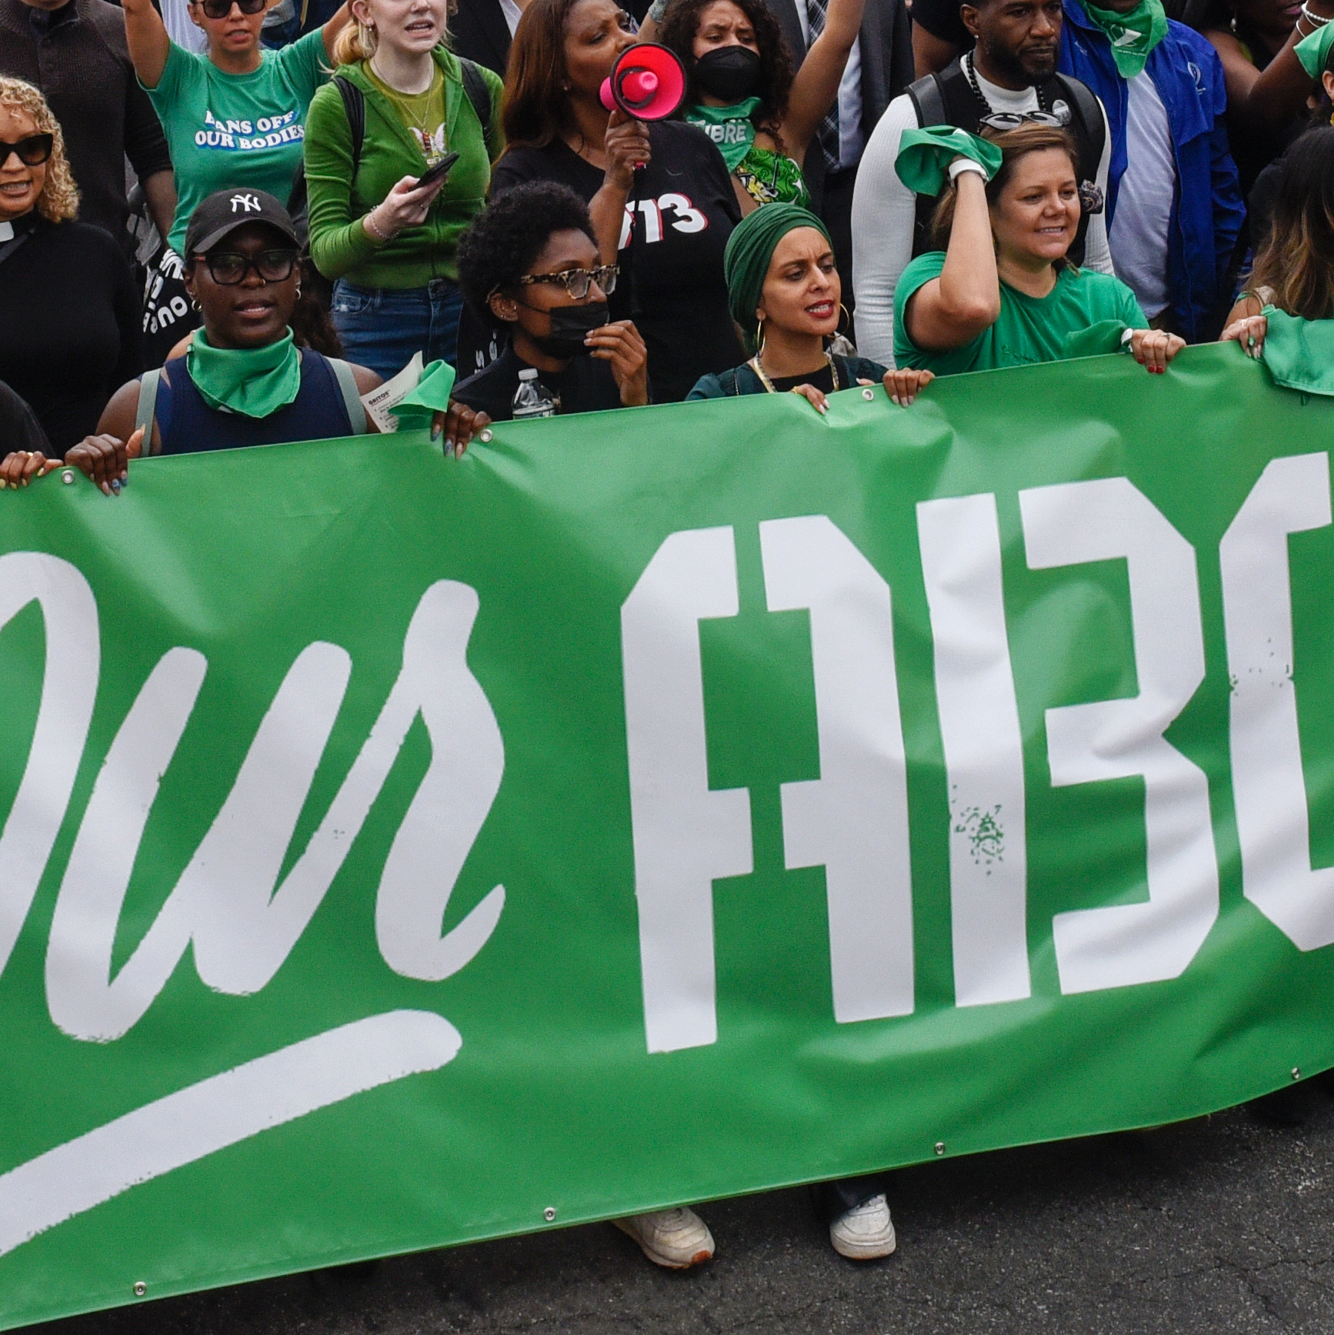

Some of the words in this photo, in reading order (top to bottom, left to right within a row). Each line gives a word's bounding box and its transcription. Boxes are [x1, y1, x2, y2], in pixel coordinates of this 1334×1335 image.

[257, 111, 297, 133] OFF
[195, 129, 235, 149] OUR
[240, 125, 304, 150] BODIES
[705, 124, 747, 145] IBRE
[230, 194, 261, 213] NY
